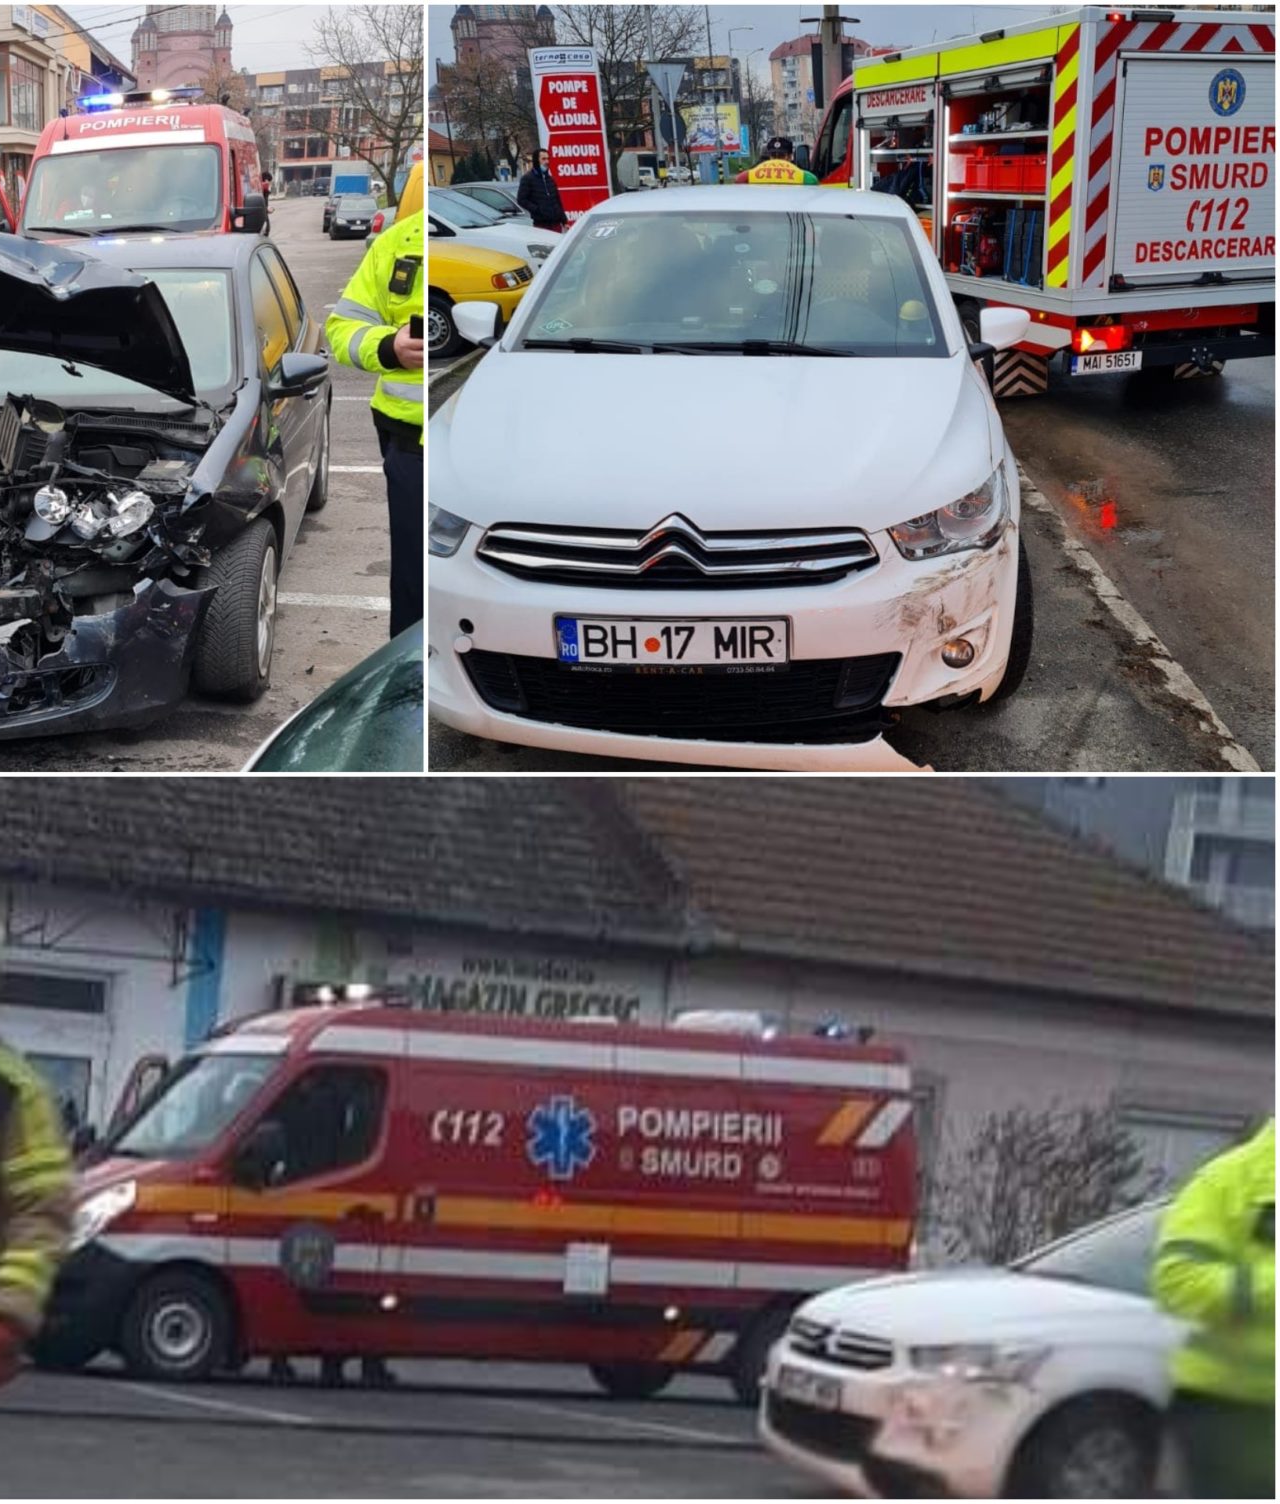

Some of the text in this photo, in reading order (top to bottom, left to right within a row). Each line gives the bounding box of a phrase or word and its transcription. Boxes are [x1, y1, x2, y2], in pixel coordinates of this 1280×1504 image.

[548, 80, 589, 94] POMPE
[562, 97, 578, 110] DE
[866, 86, 927, 109] DESCARCERARE
[79, 115, 180, 133] POMPIERII
[548, 110, 597, 127] CĂLDURĂ
[1144, 126, 1276, 156] POMPIER
[551, 144, 600, 158] PANOURI
[557, 163, 598, 177] SOLARE
[754, 167, 796, 180] CITY
[1170, 162, 1268, 191] SMURD
[1200, 197, 1250, 232] 112
[594, 226, 616, 238] 17
[1134, 236, 1276, 264] DESCARCERAR
[1083, 353, 1136, 370] MAI 51651
[561, 642, 578, 657] RO
[582, 625, 775, 660] BH 17 MIR
[449, 1111, 504, 1144] 112
[617, 1106, 783, 1144] POMPIERII
[640, 1151, 742, 1179] SMURD
